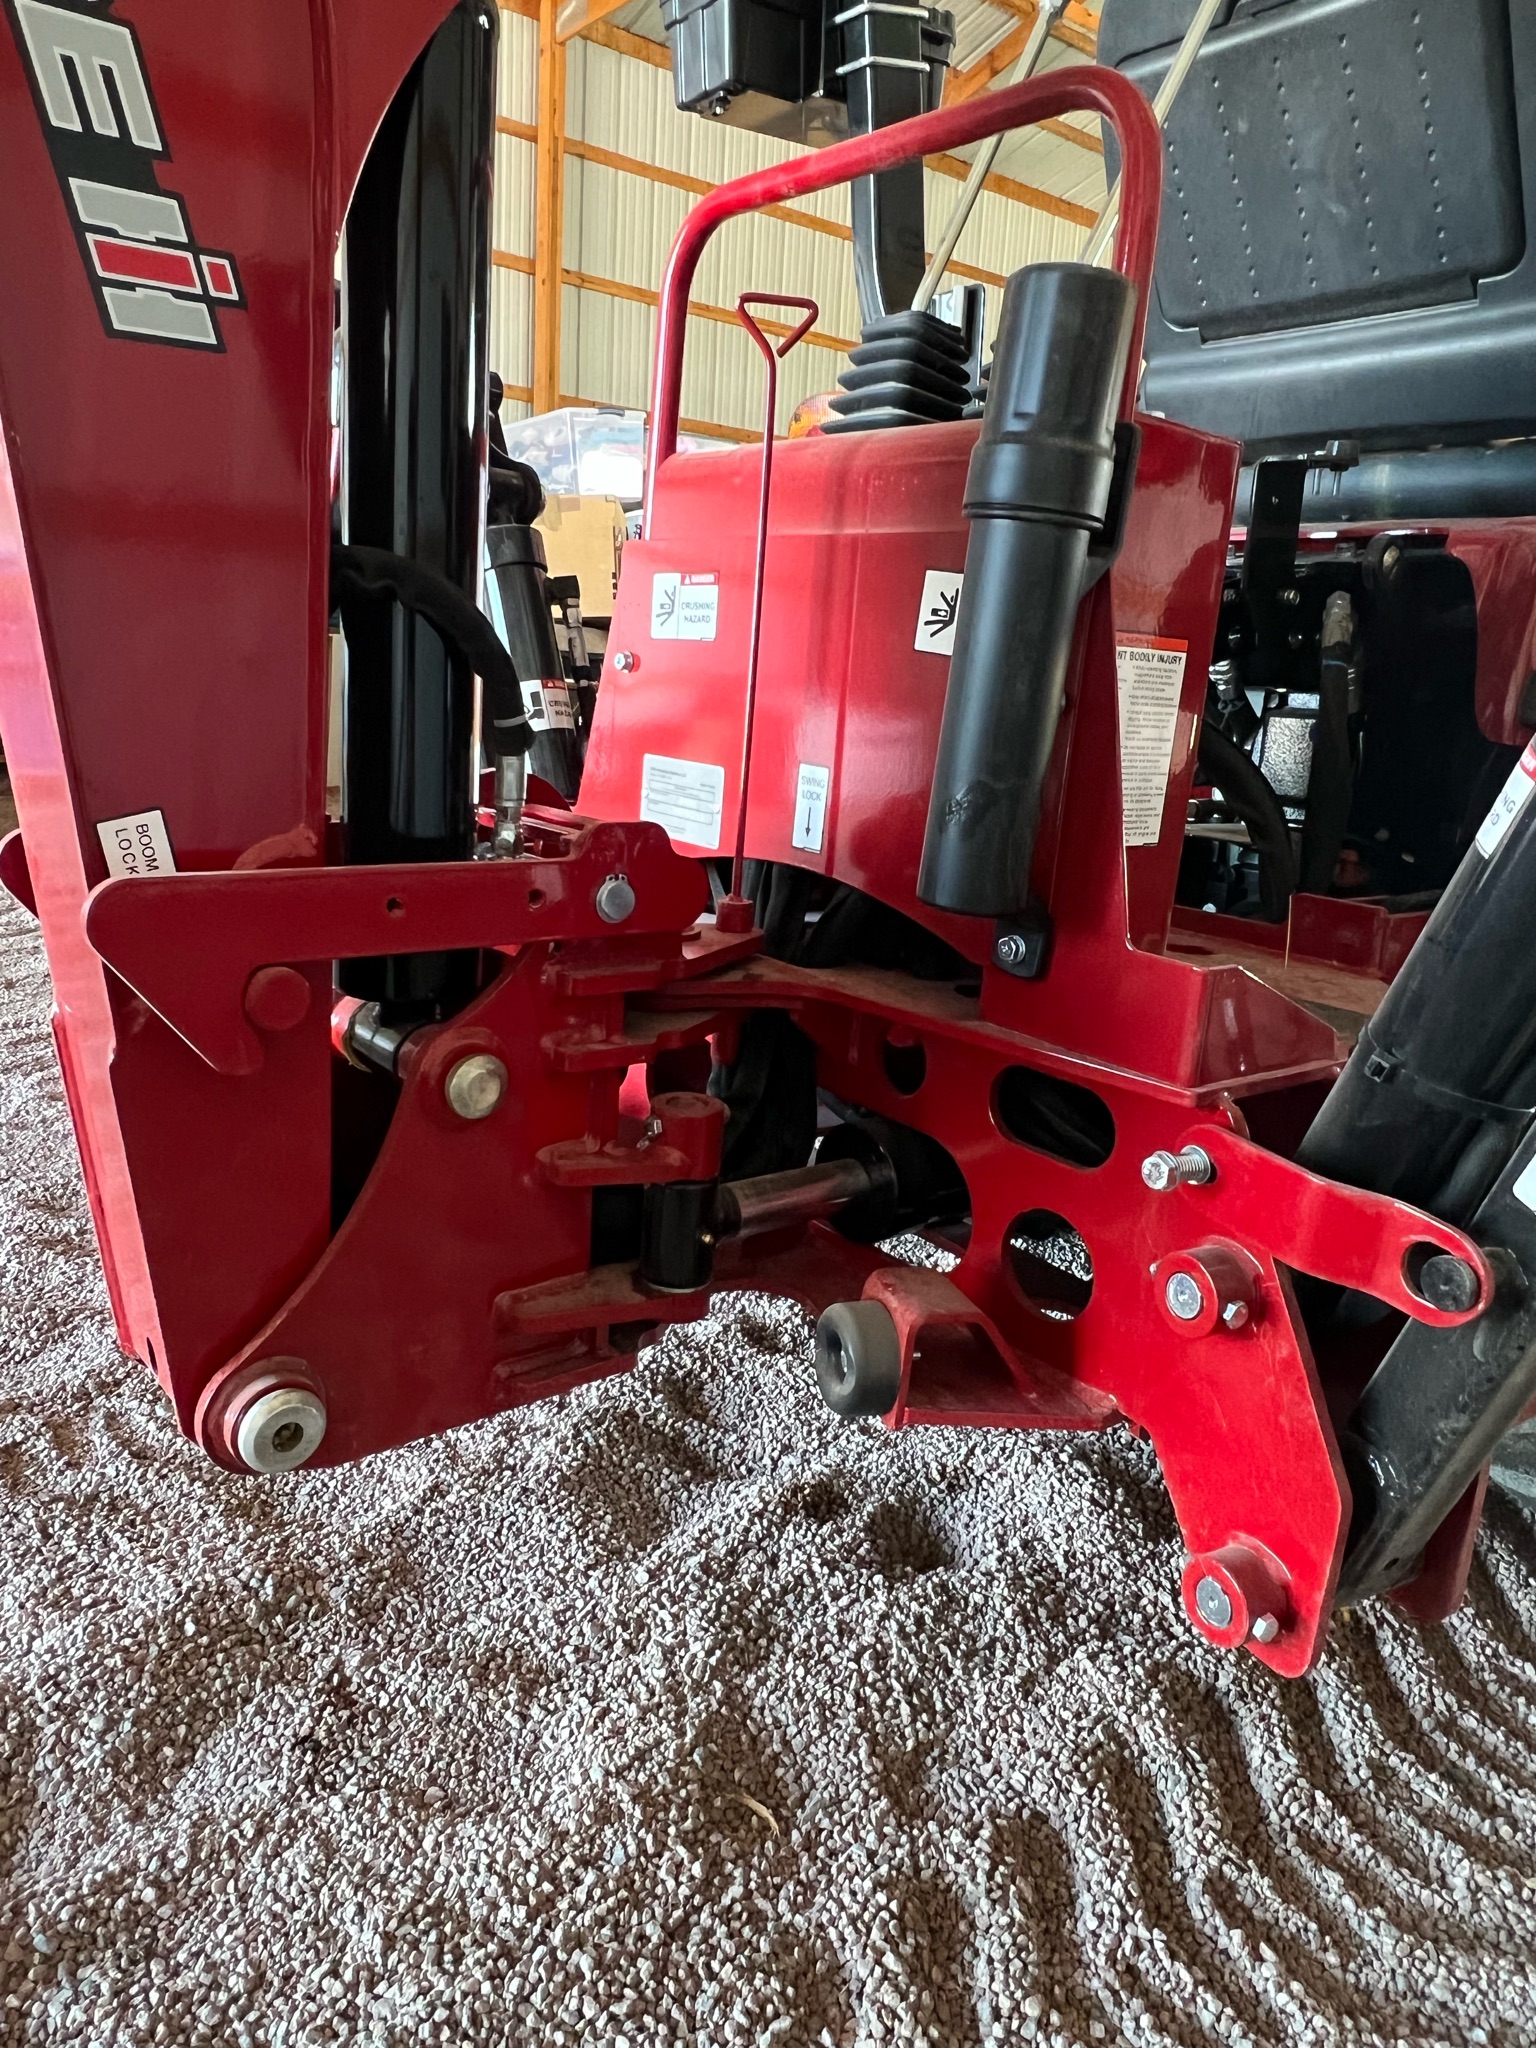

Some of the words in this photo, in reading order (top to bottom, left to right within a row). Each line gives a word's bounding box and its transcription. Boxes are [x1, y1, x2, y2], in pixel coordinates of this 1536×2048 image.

[681, 602, 715, 611] CRUSHING
[684, 615, 711, 623] HAZARD
[1130, 651, 1156, 663] BODILY
[1157, 654, 1183, 665] INJURY
[801, 776, 826, 788] SWING
[802, 791, 822, 802] LOCK
[115, 828, 140, 875] LOCK
[135, 823, 160, 872] BOOM
